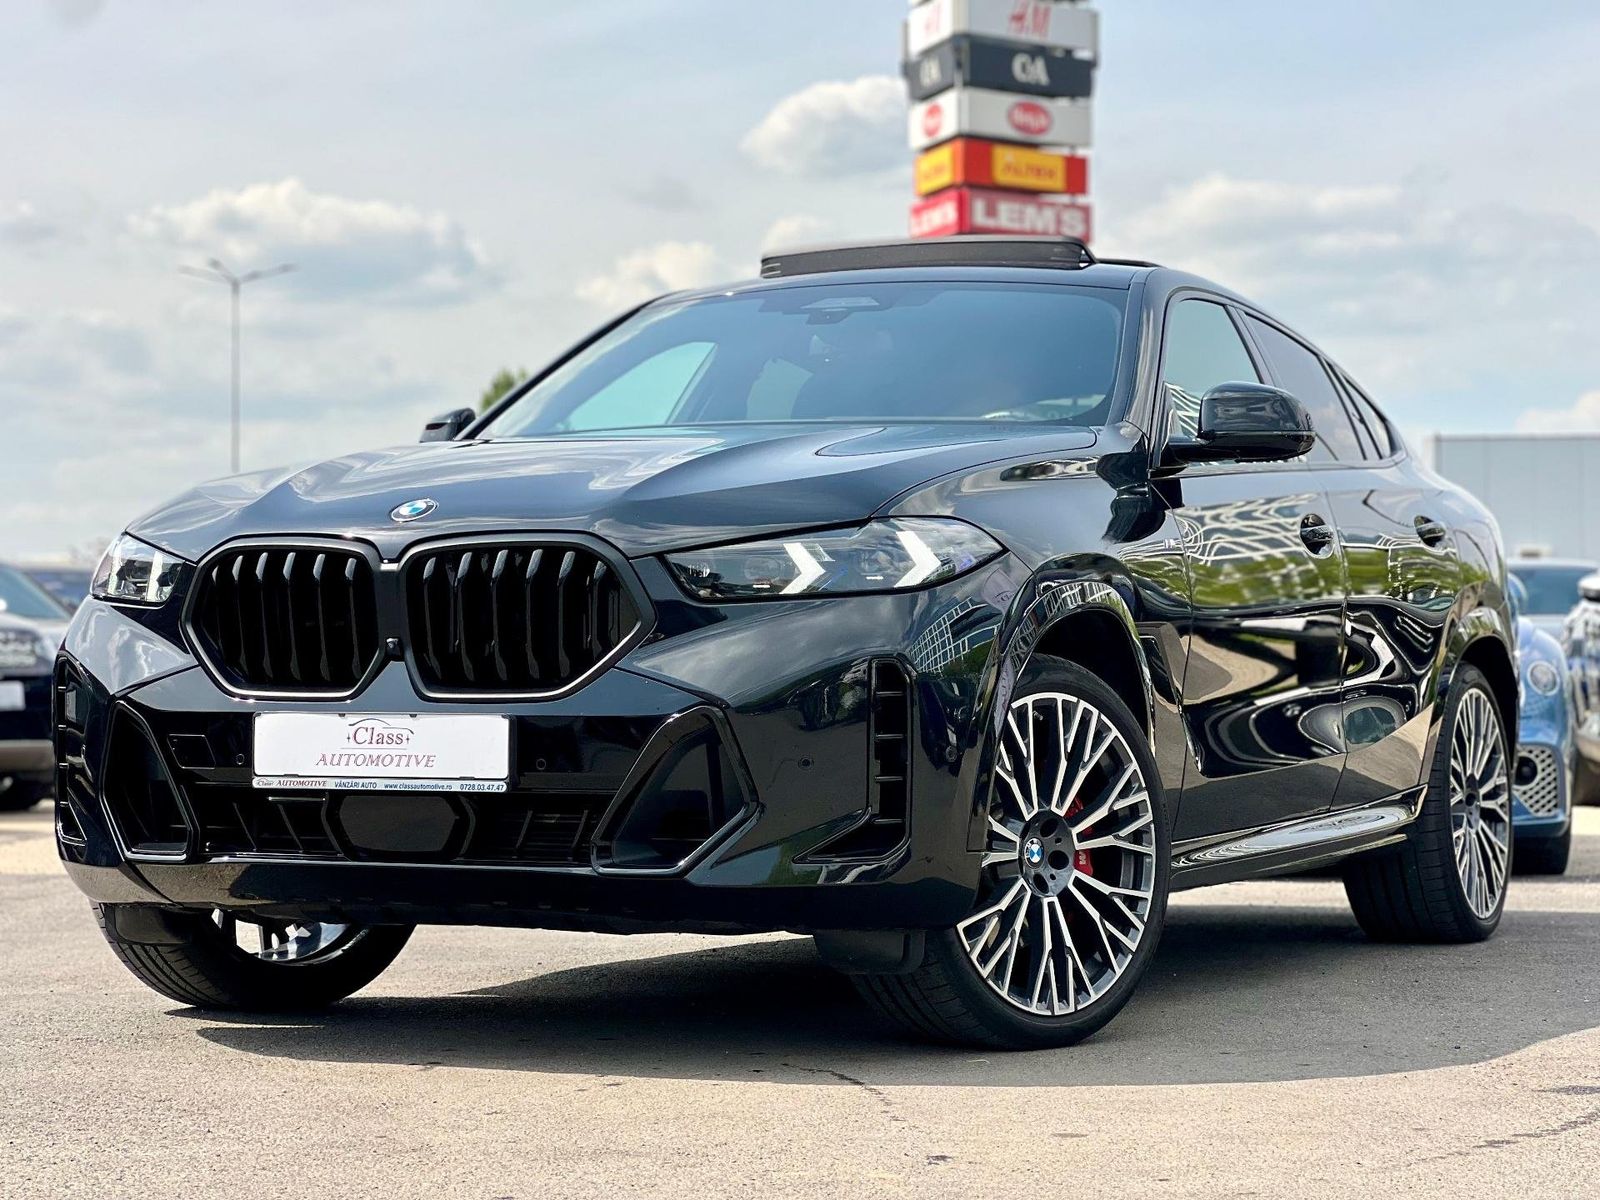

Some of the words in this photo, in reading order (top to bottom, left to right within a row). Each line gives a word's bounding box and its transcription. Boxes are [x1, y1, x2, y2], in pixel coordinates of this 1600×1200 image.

[353, 726, 405, 745] Class
[316, 753, 436, 767] AUTOMOTIVE
[361, 781, 378, 789] AUTO
